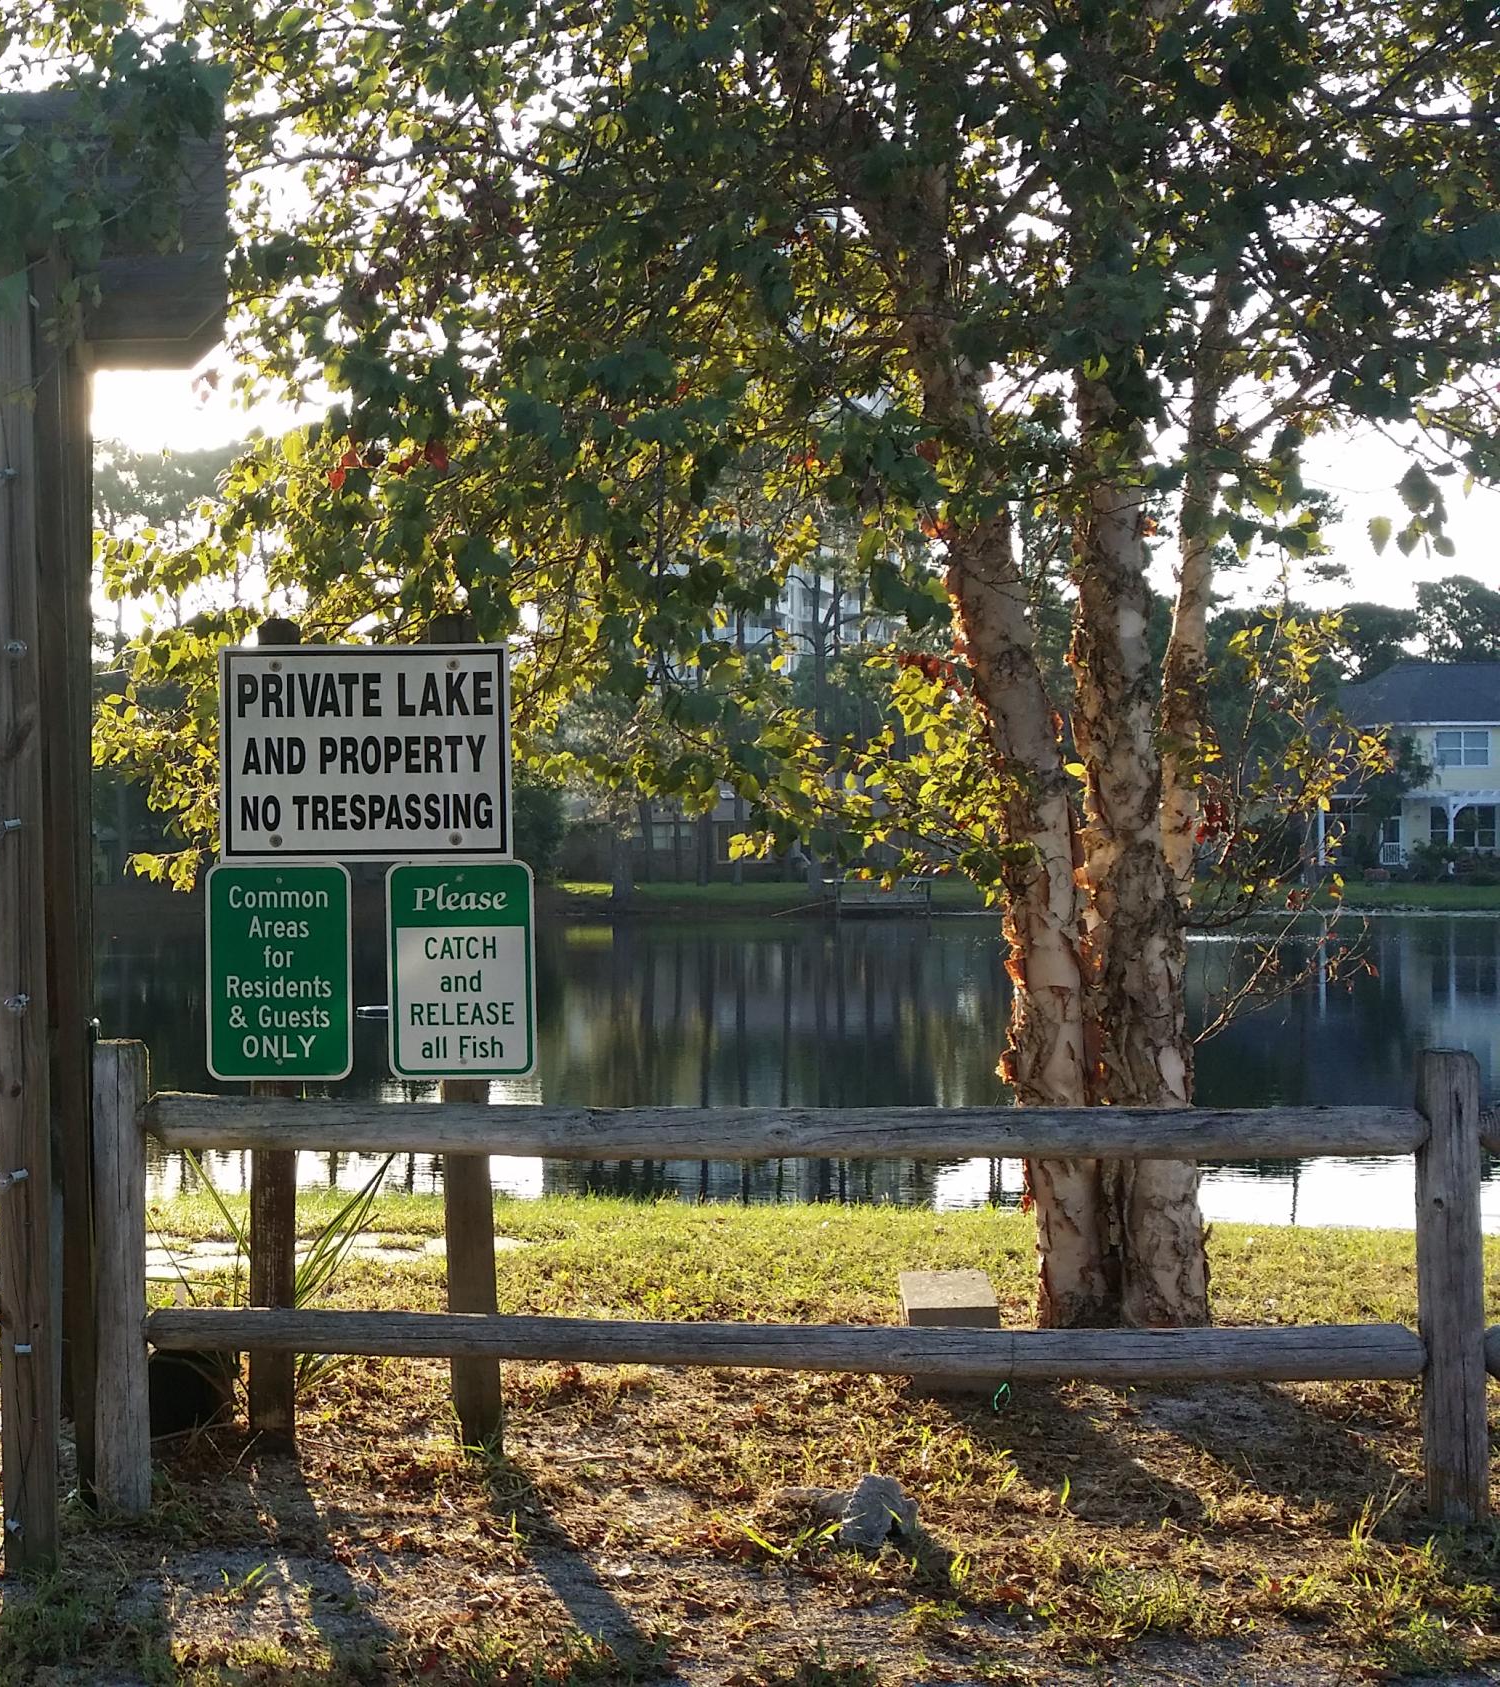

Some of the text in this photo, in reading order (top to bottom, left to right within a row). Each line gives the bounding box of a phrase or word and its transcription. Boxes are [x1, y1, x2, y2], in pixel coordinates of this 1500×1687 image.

[237, 671, 493, 718] PRIVATE LAKE
[242, 735, 486, 775] AND PROPERTY
[240, 793, 493, 831] NO TRESPASSING
[229, 885, 329, 909] Common
[412, 883, 509, 912] Please
[249, 915, 310, 938] Areas
[263, 945, 294, 968] for
[424, 936, 497, 959] CATCH
[226, 975, 332, 998] Residents
[440, 970, 482, 992] and
[229, 1005, 331, 1028] & Guests
[411, 1002, 515, 1026] RELEASE
[243, 1035, 317, 1058] ONLY
[422, 1036, 504, 1059] all Fish
